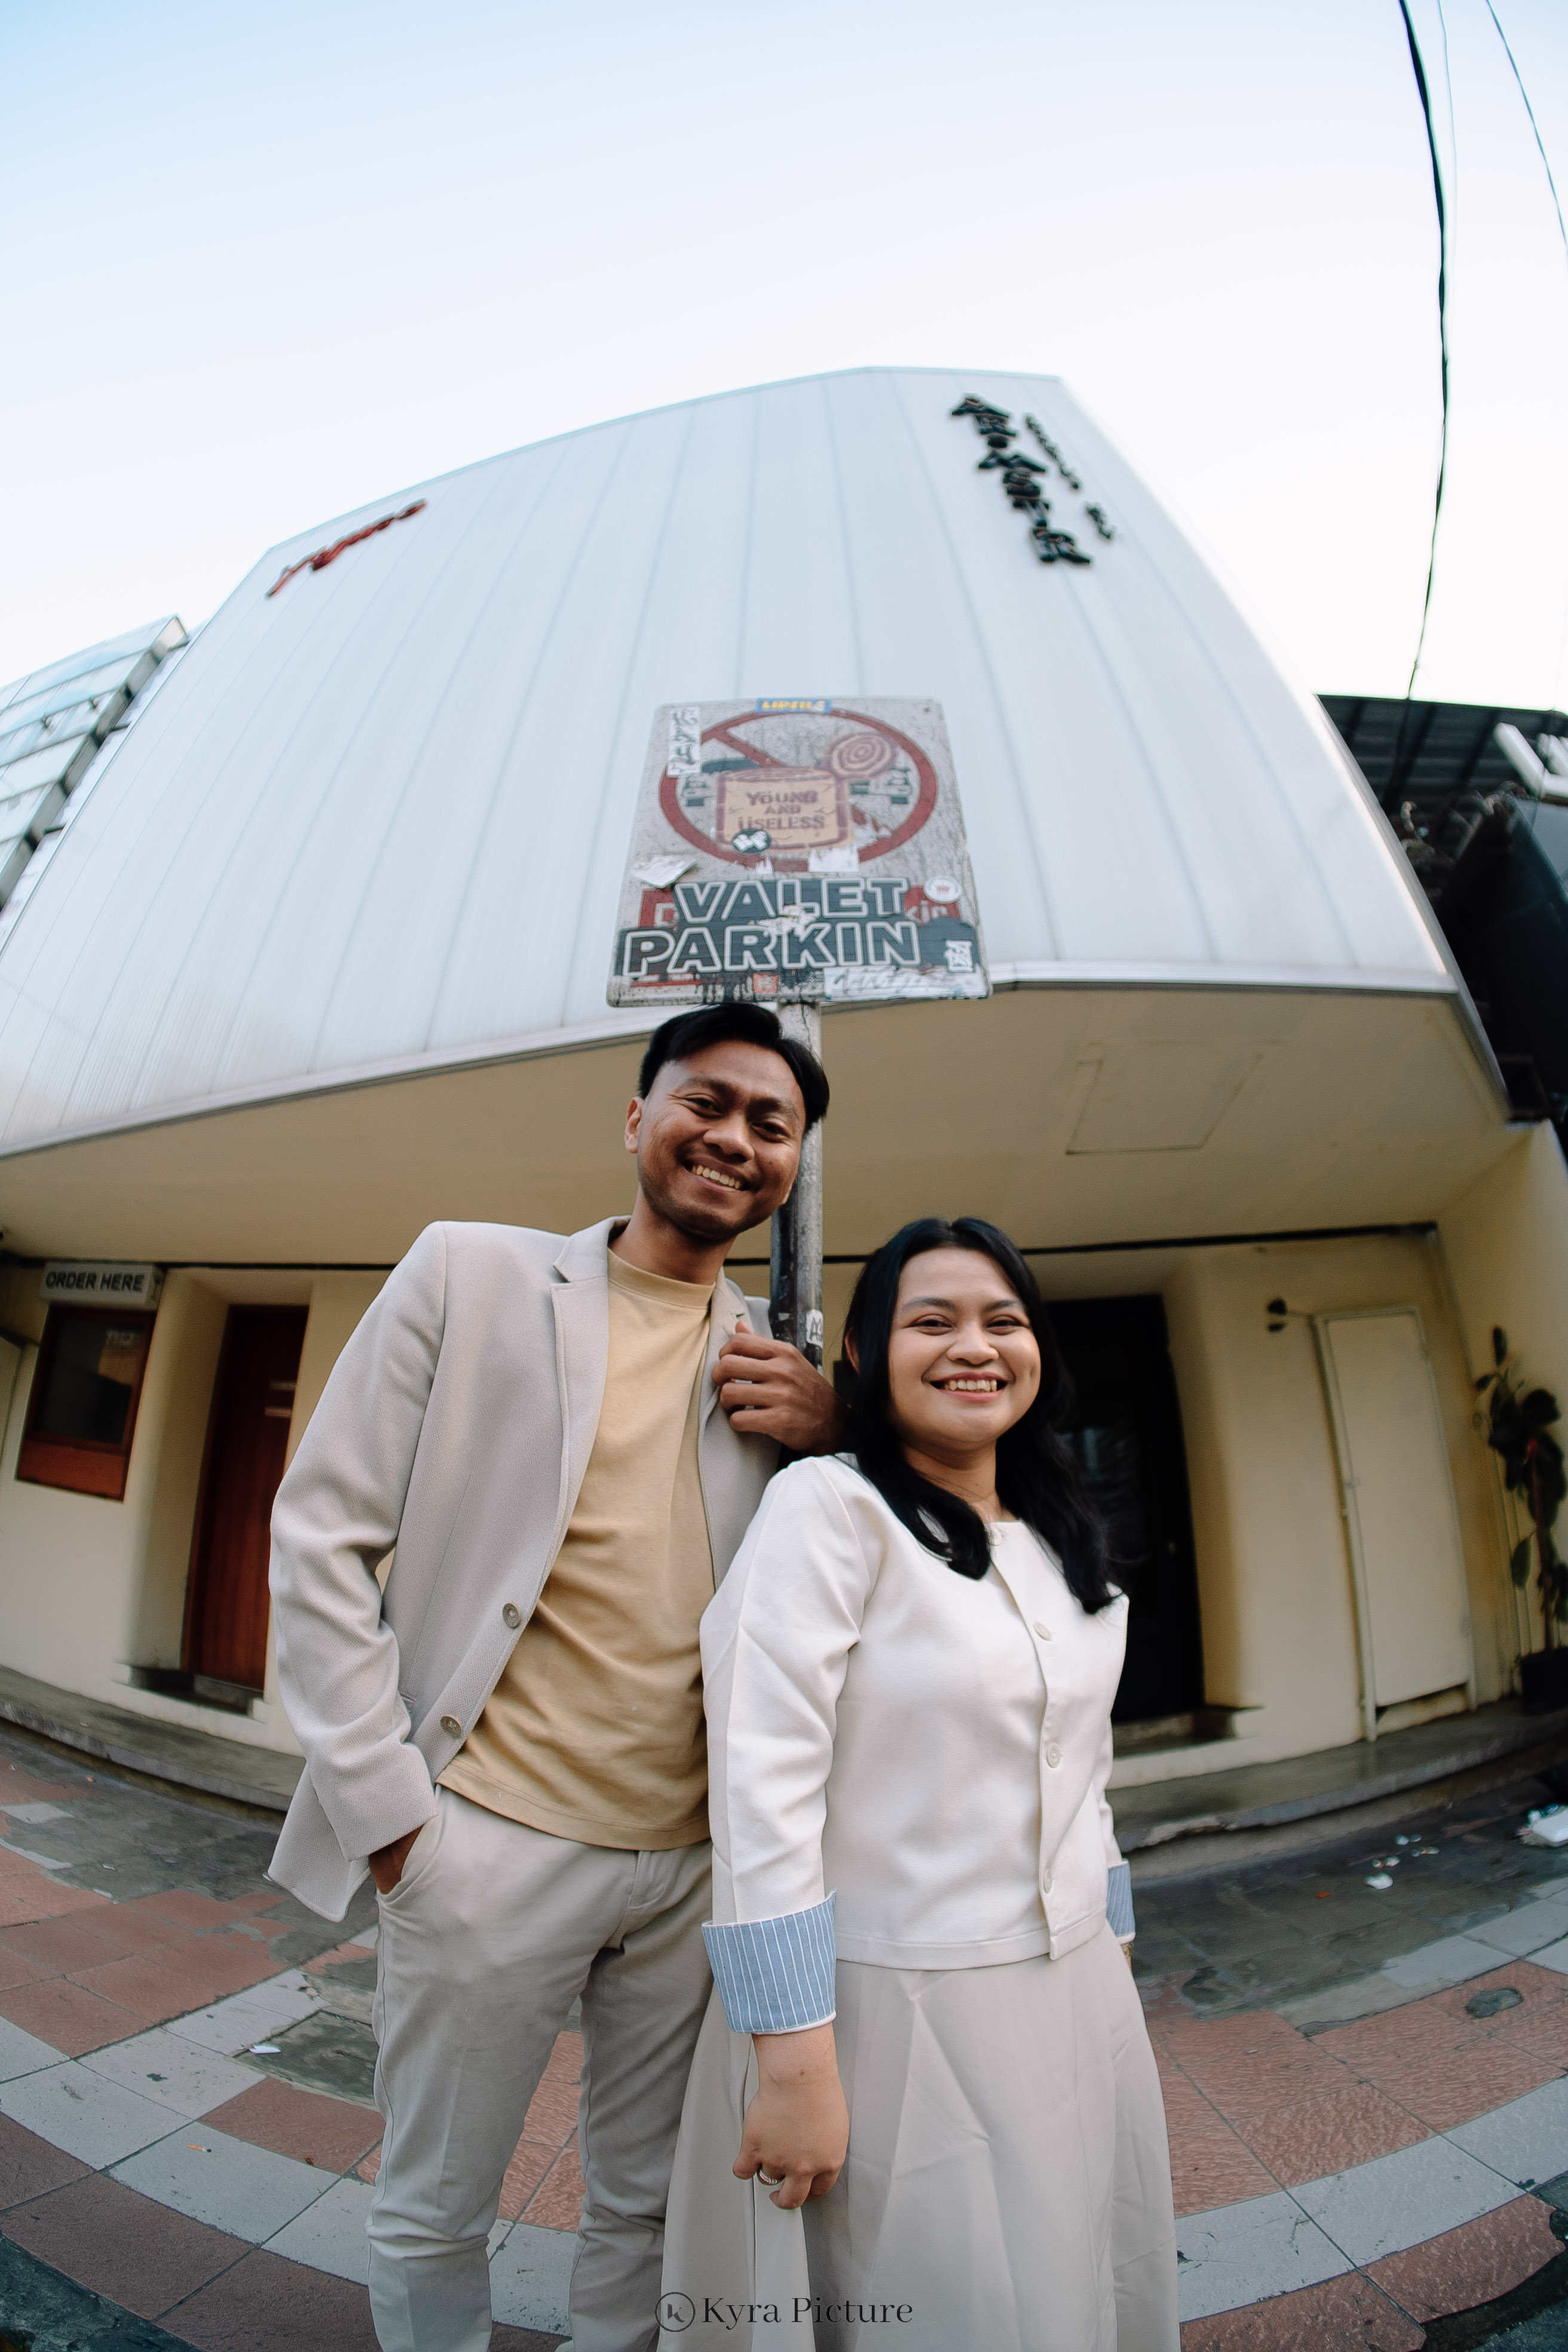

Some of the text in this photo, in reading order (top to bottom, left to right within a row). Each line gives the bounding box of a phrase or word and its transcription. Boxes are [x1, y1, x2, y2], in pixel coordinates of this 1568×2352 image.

[747, 791, 817, 806] YOUNG
[764, 806, 801, 814] AND
[675, 878, 909, 923] VALET
[623, 922, 921, 976] PARKIN
[45, 1272, 145, 1292] ORDER HERE
